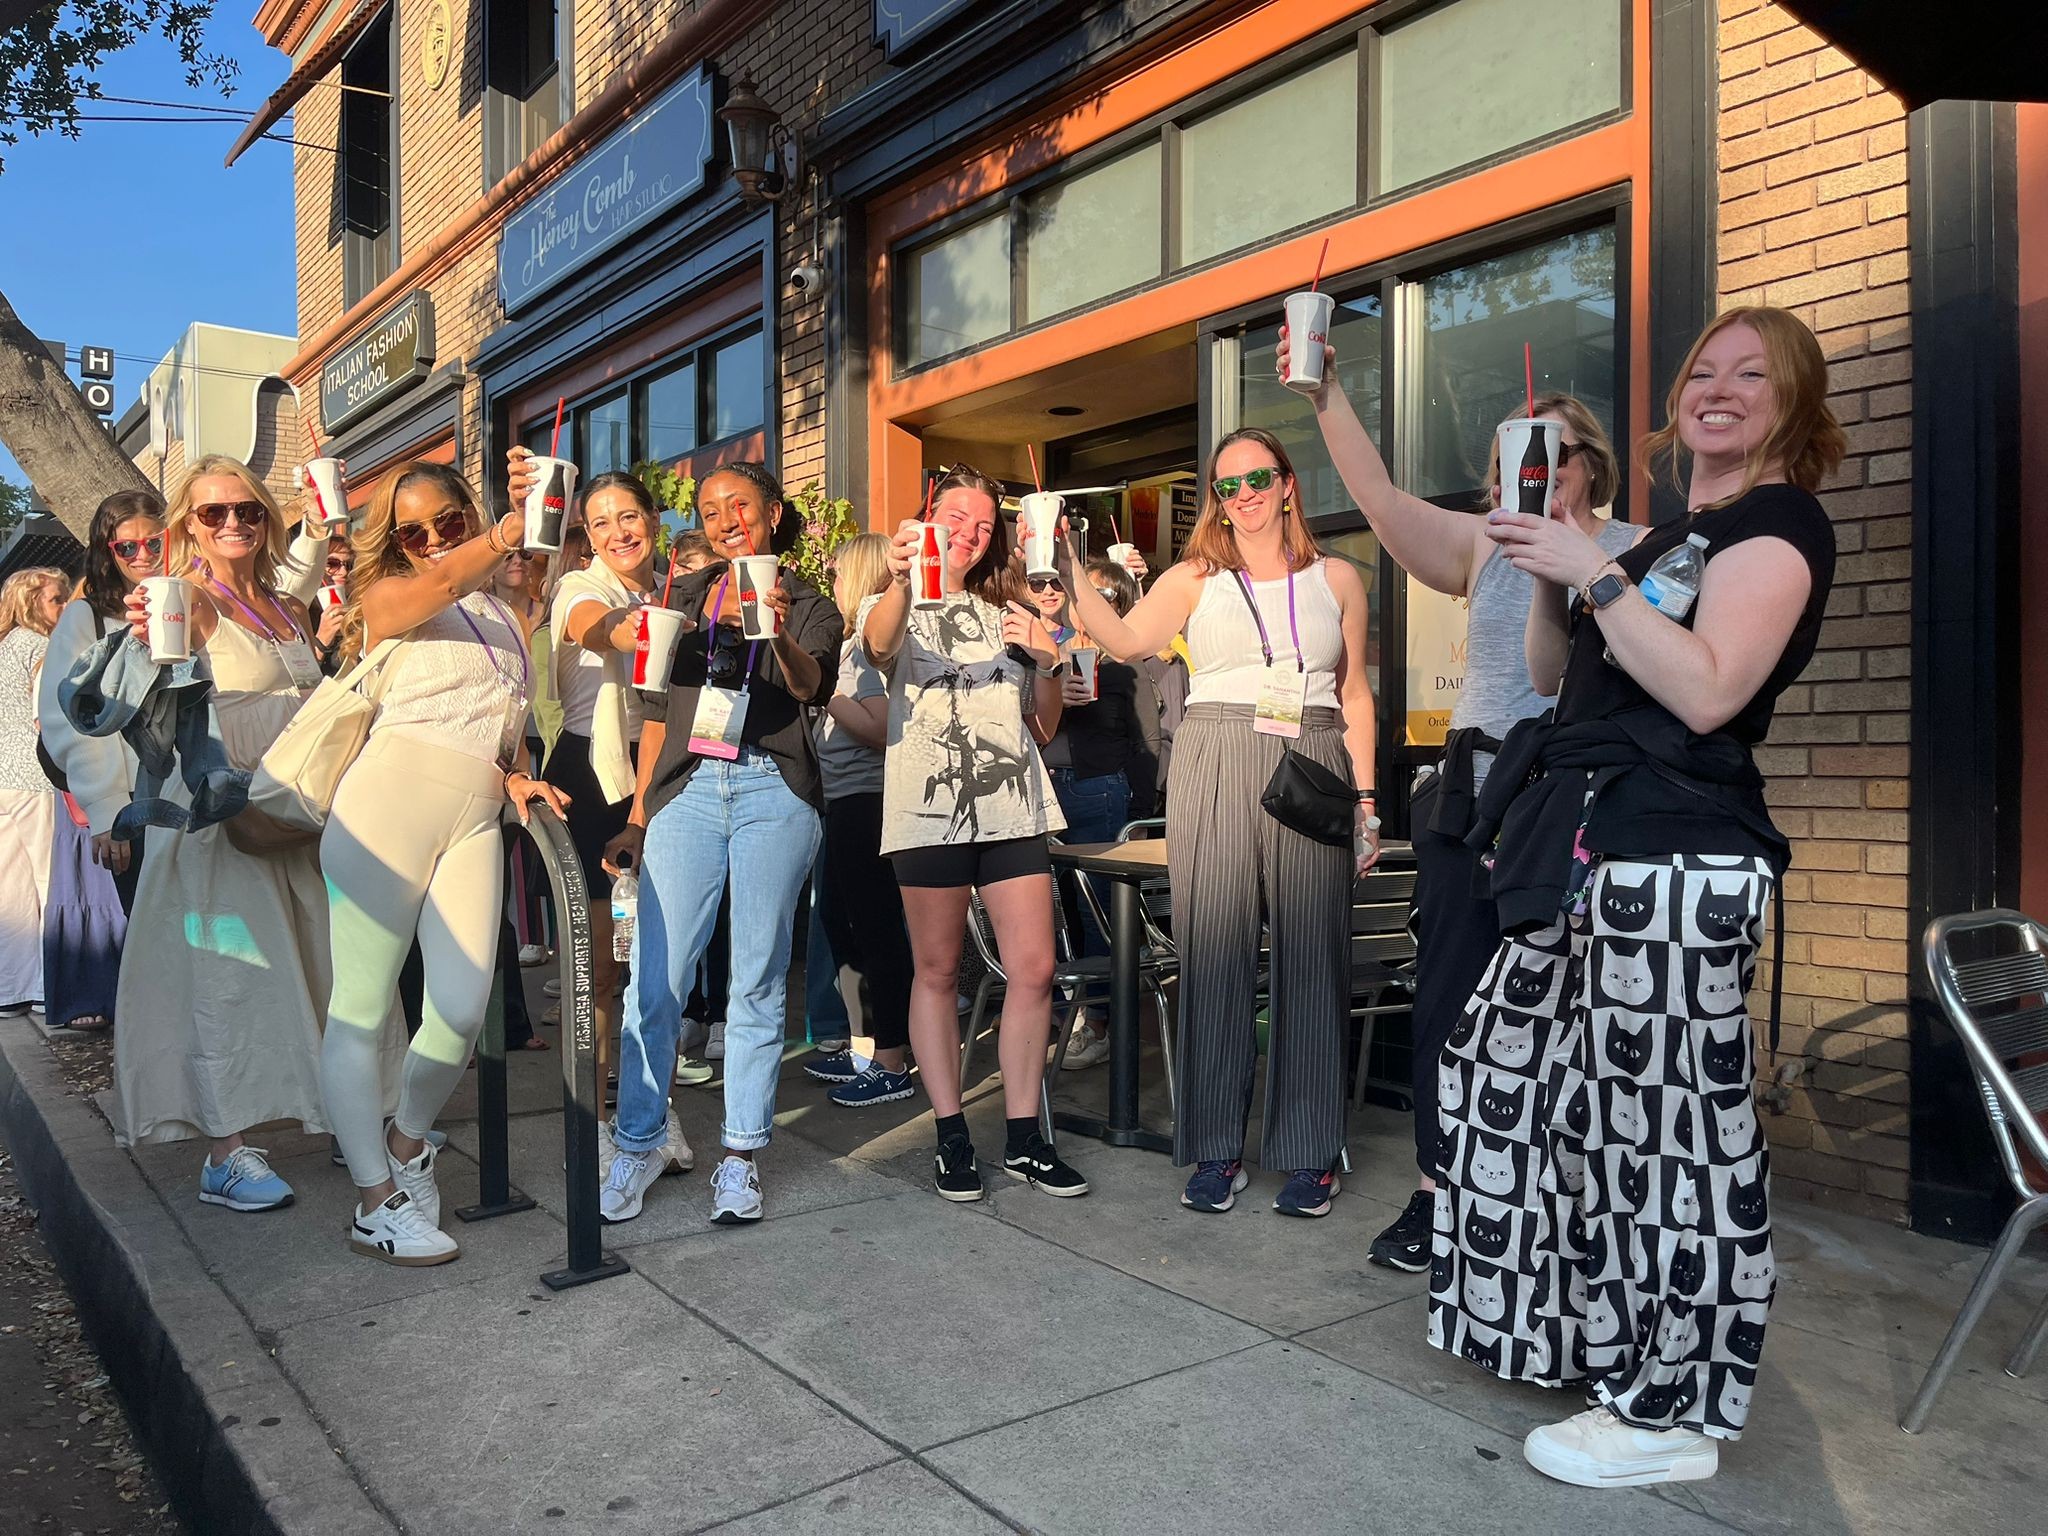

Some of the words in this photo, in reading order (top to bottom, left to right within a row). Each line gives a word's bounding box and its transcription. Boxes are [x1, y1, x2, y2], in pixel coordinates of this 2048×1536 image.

[635, 173, 673, 212] STUDIO
[522, 208, 581, 287] Honey
[583, 153, 637, 234] Comb
[326, 351, 363, 395] ITALIAN
[366, 312, 413, 367] FASHION
[347, 362, 389, 406] SCHOOL
[1522, 479, 1546, 488] zero
[544, 505, 563, 515] zero
[574, 937, 590, 992] SUPPORTS
